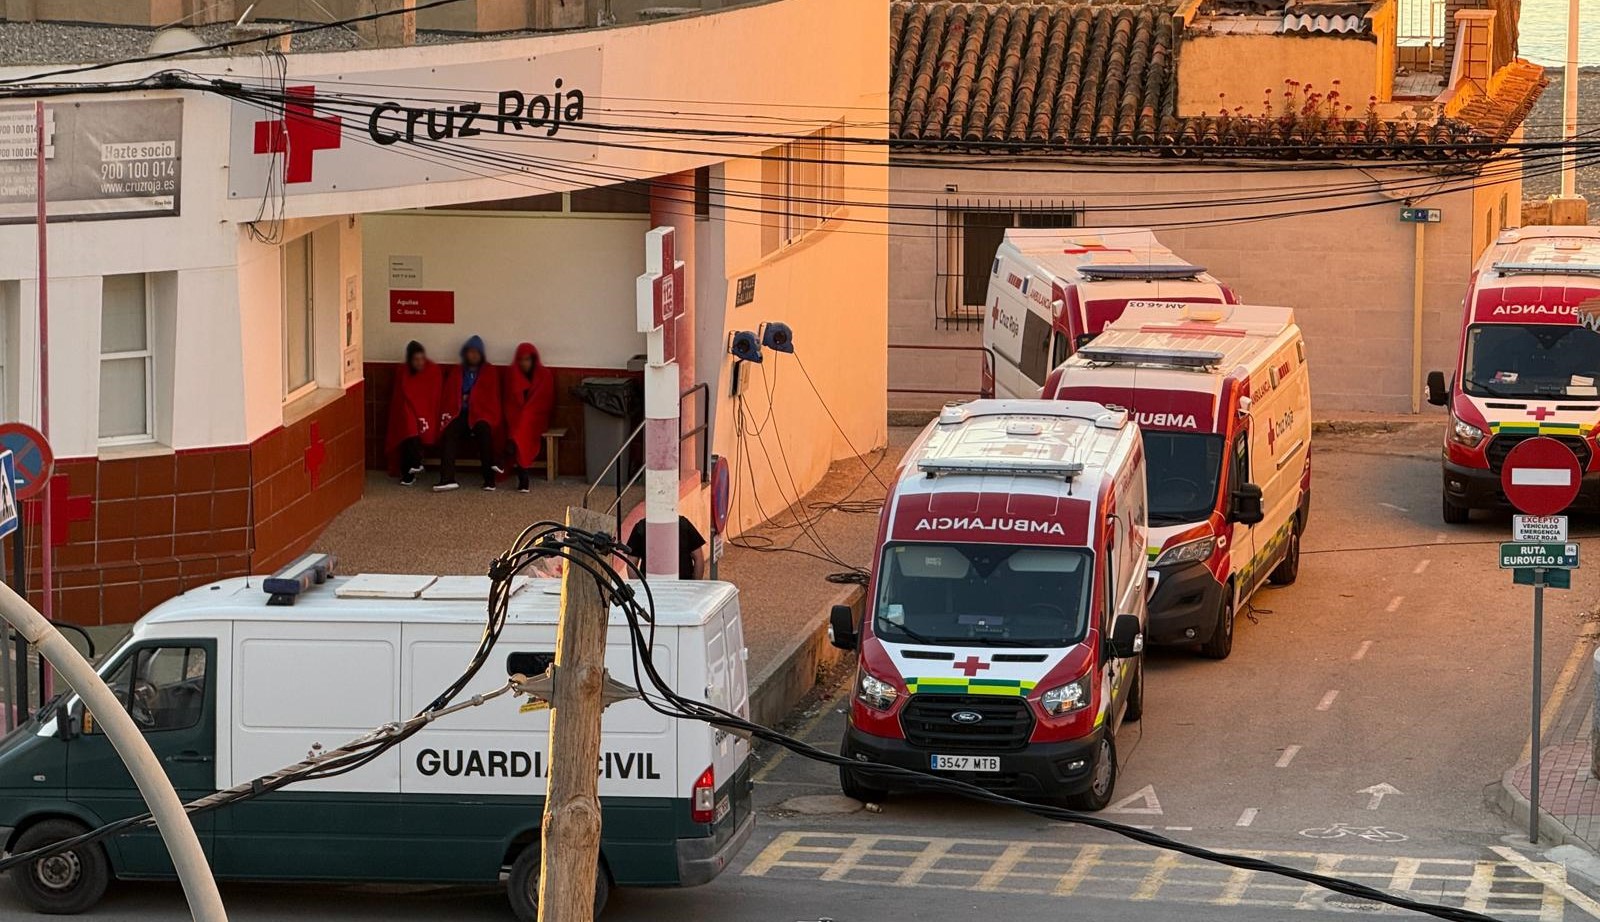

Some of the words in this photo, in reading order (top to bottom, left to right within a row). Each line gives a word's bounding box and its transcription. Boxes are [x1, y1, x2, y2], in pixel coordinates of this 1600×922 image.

[369, 101, 481, 145] Cruz
[497, 78, 584, 137] Roja
[13, 124, 24, 134] 100
[12, 148, 24, 158] 100
[105, 145, 138, 159] Hazte
[141, 142, 172, 157] socio
[101, 163, 123, 180] 900
[128, 162, 149, 179] 100
[153, 160, 175, 177] 014
[100, 179, 175, 194] www.cruzroja.es
[1521, 516, 1560, 524] EXCEPTO
[1520, 546, 1546, 555] RUTA
[1503, 556, 1555, 565] EUROVELO
[1557, 556, 1563, 565] 8
[416, 748, 551, 778] GUARDI
[597, 752, 661, 779] IVIL
[940, 757, 969, 769] 3547
[973, 758, 997, 770] MTB
